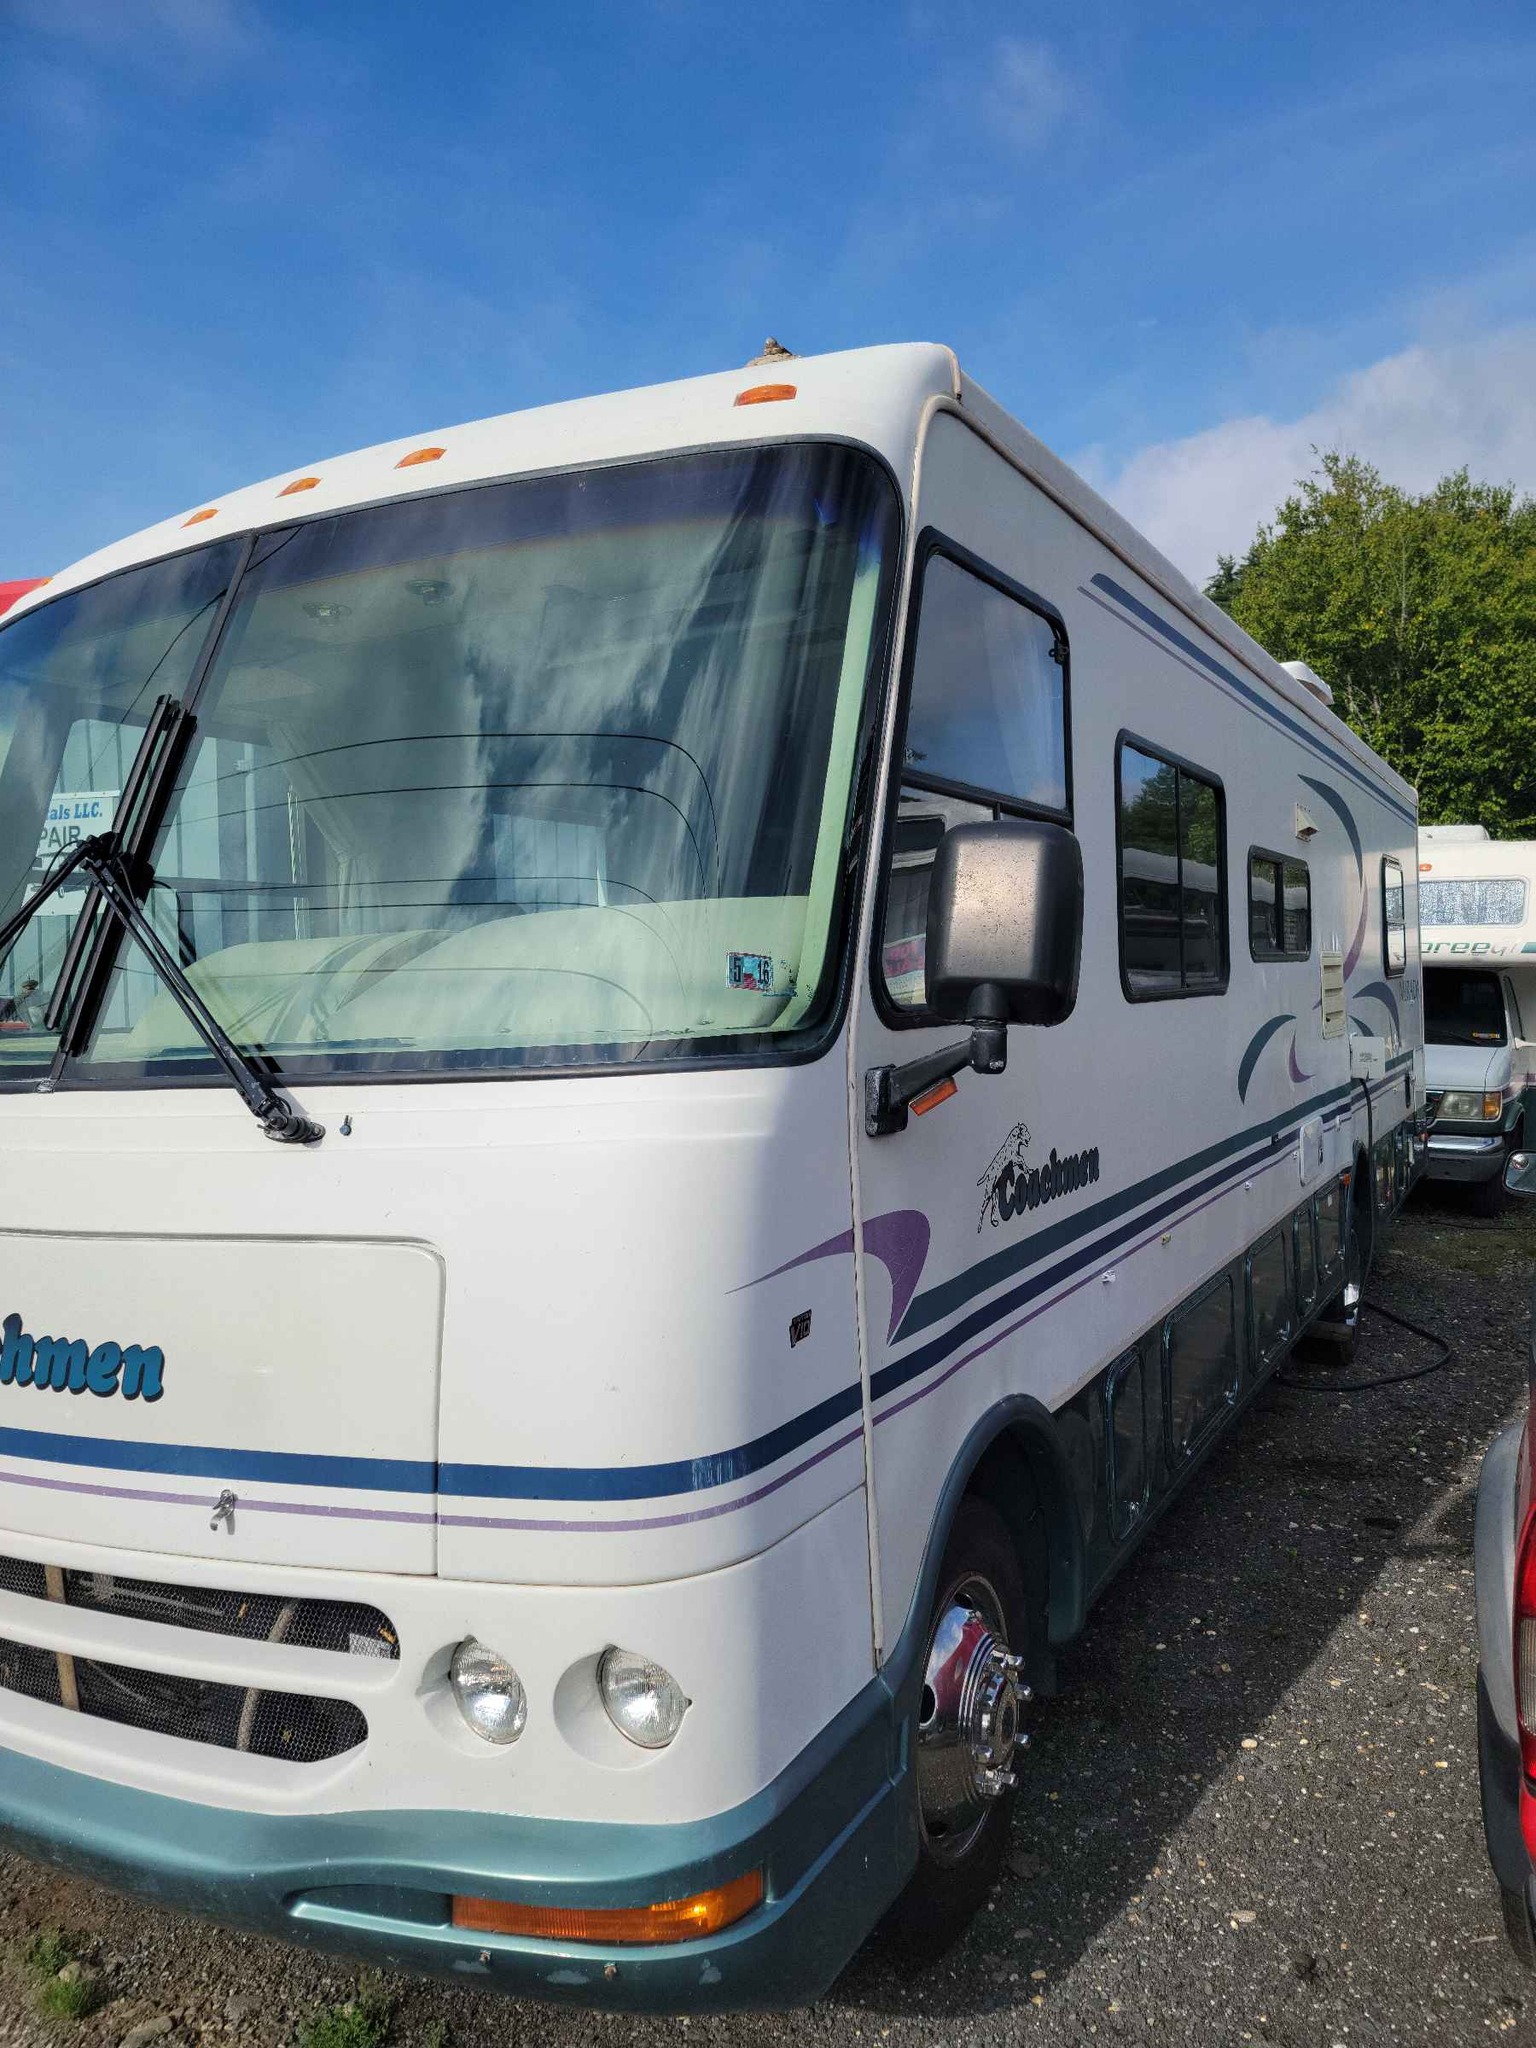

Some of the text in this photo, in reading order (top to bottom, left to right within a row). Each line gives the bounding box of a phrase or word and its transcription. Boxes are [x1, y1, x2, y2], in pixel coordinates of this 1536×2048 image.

[74, 802, 103, 819] LLC.
[997, 1146, 1100, 1221] Coachmen
[0, 1312, 165, 1403] hmen
